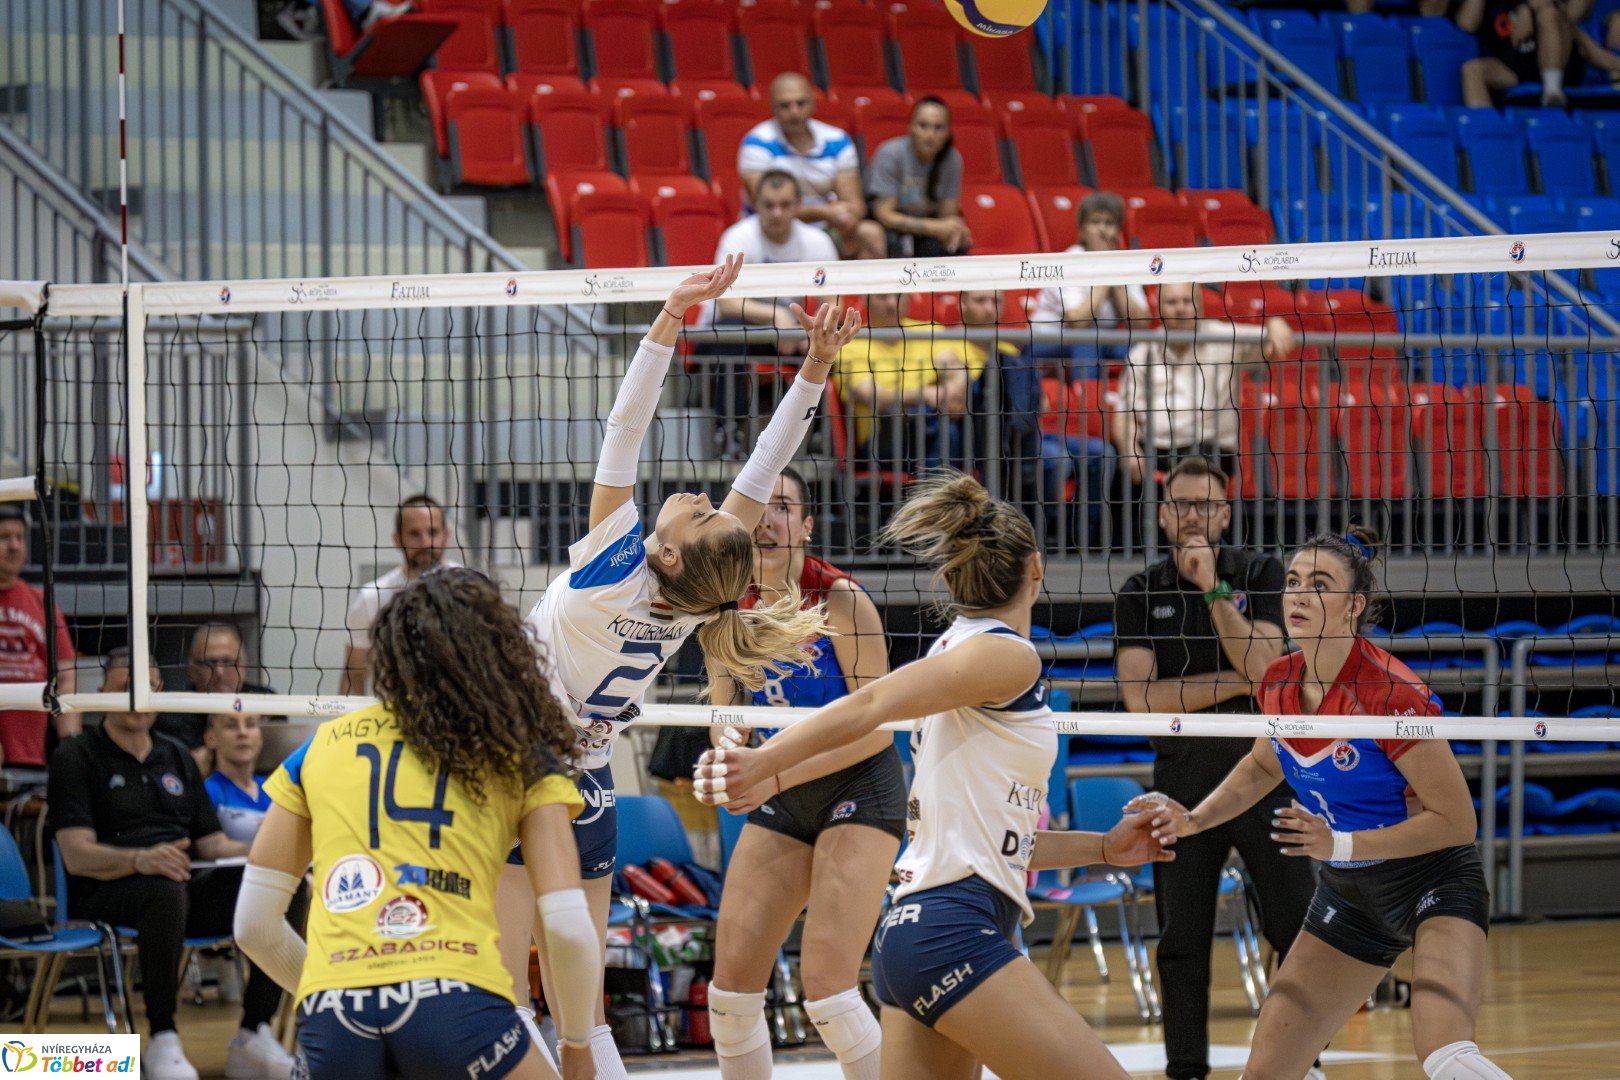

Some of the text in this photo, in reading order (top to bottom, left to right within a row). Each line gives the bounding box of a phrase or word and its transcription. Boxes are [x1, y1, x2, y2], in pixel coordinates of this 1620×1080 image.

[585, 640, 665, 708] 2
[356, 740, 455, 849] 14
[329, 939, 479, 965] SZABADICS
[913, 962, 974, 1017] FLASH
